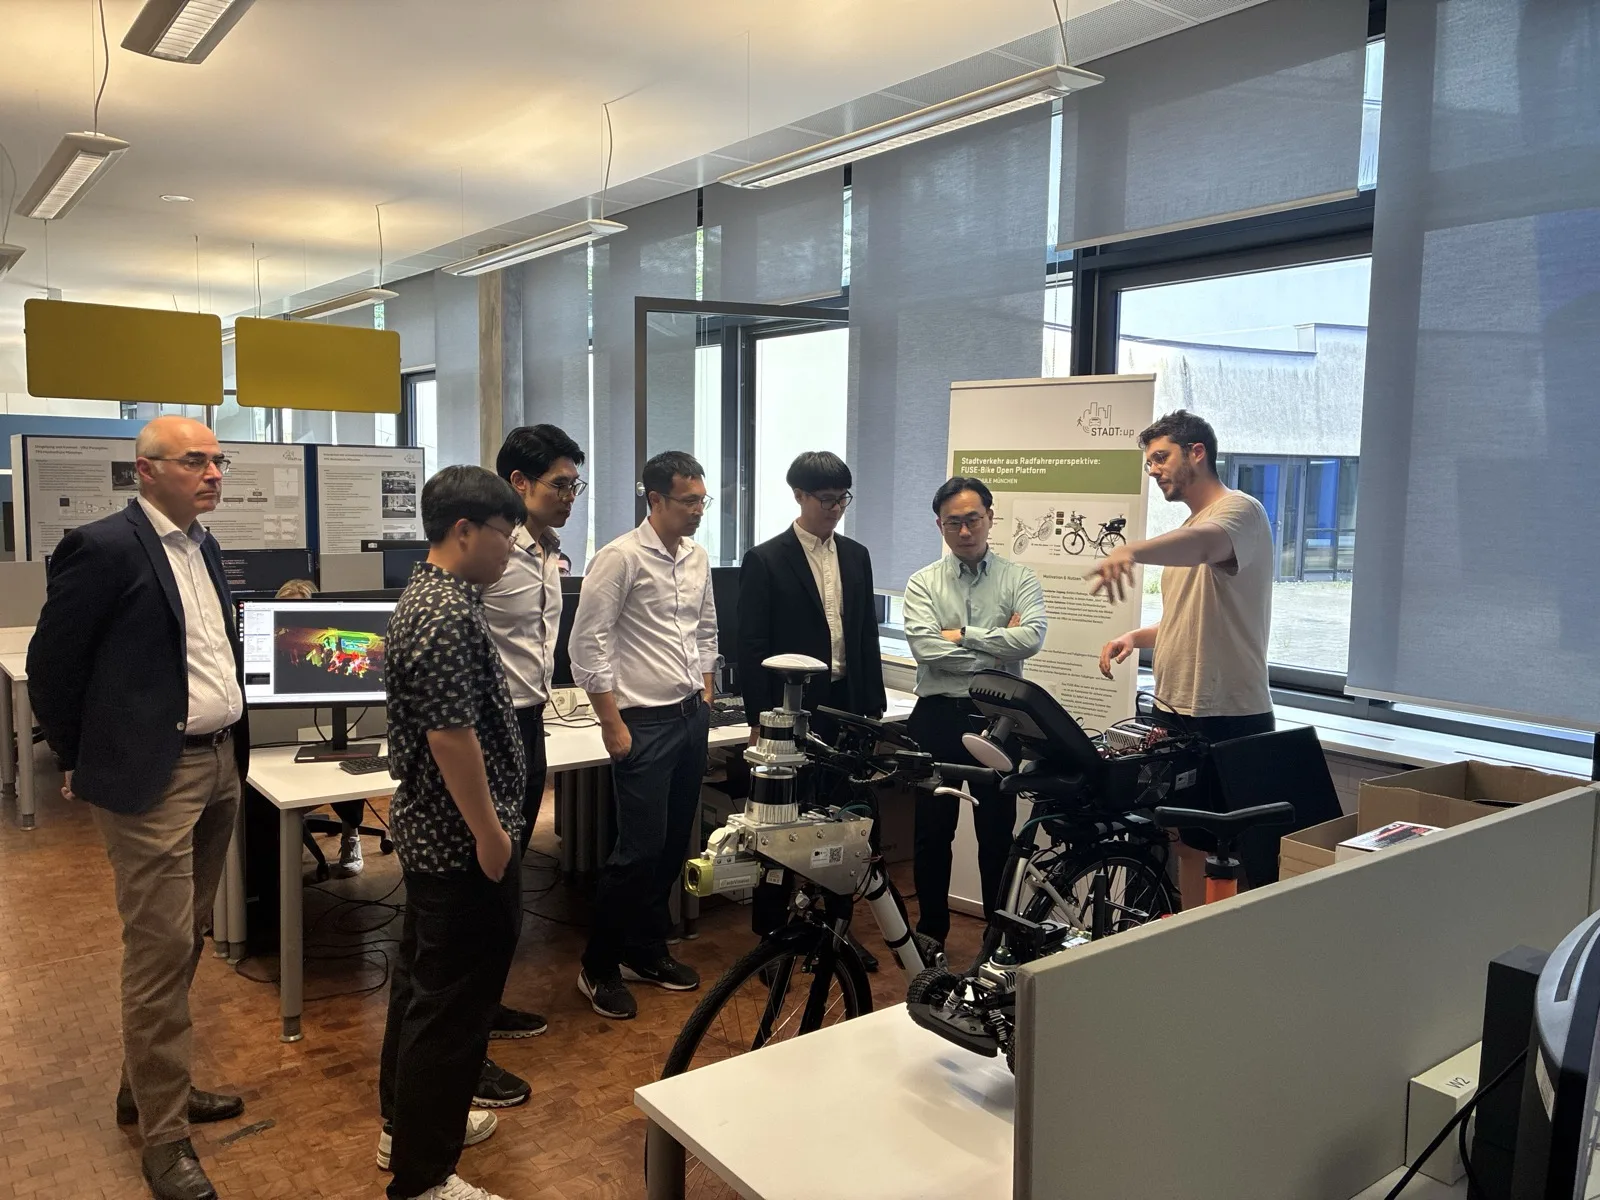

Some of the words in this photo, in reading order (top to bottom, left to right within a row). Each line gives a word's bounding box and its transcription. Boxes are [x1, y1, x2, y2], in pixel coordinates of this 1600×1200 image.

[1091, 427, 1134, 438] STADT:up
[961, 457, 1004, 465] Stadtverkehr
[1020, 457, 1101, 467] Radfahrerperspektive:
[961, 466, 995, 474] FUSE-Bike
[996, 466, 1014, 475] Open
[1015, 466, 1047, 474] Platform
[992, 476, 1018, 484] MÜNCHEN
